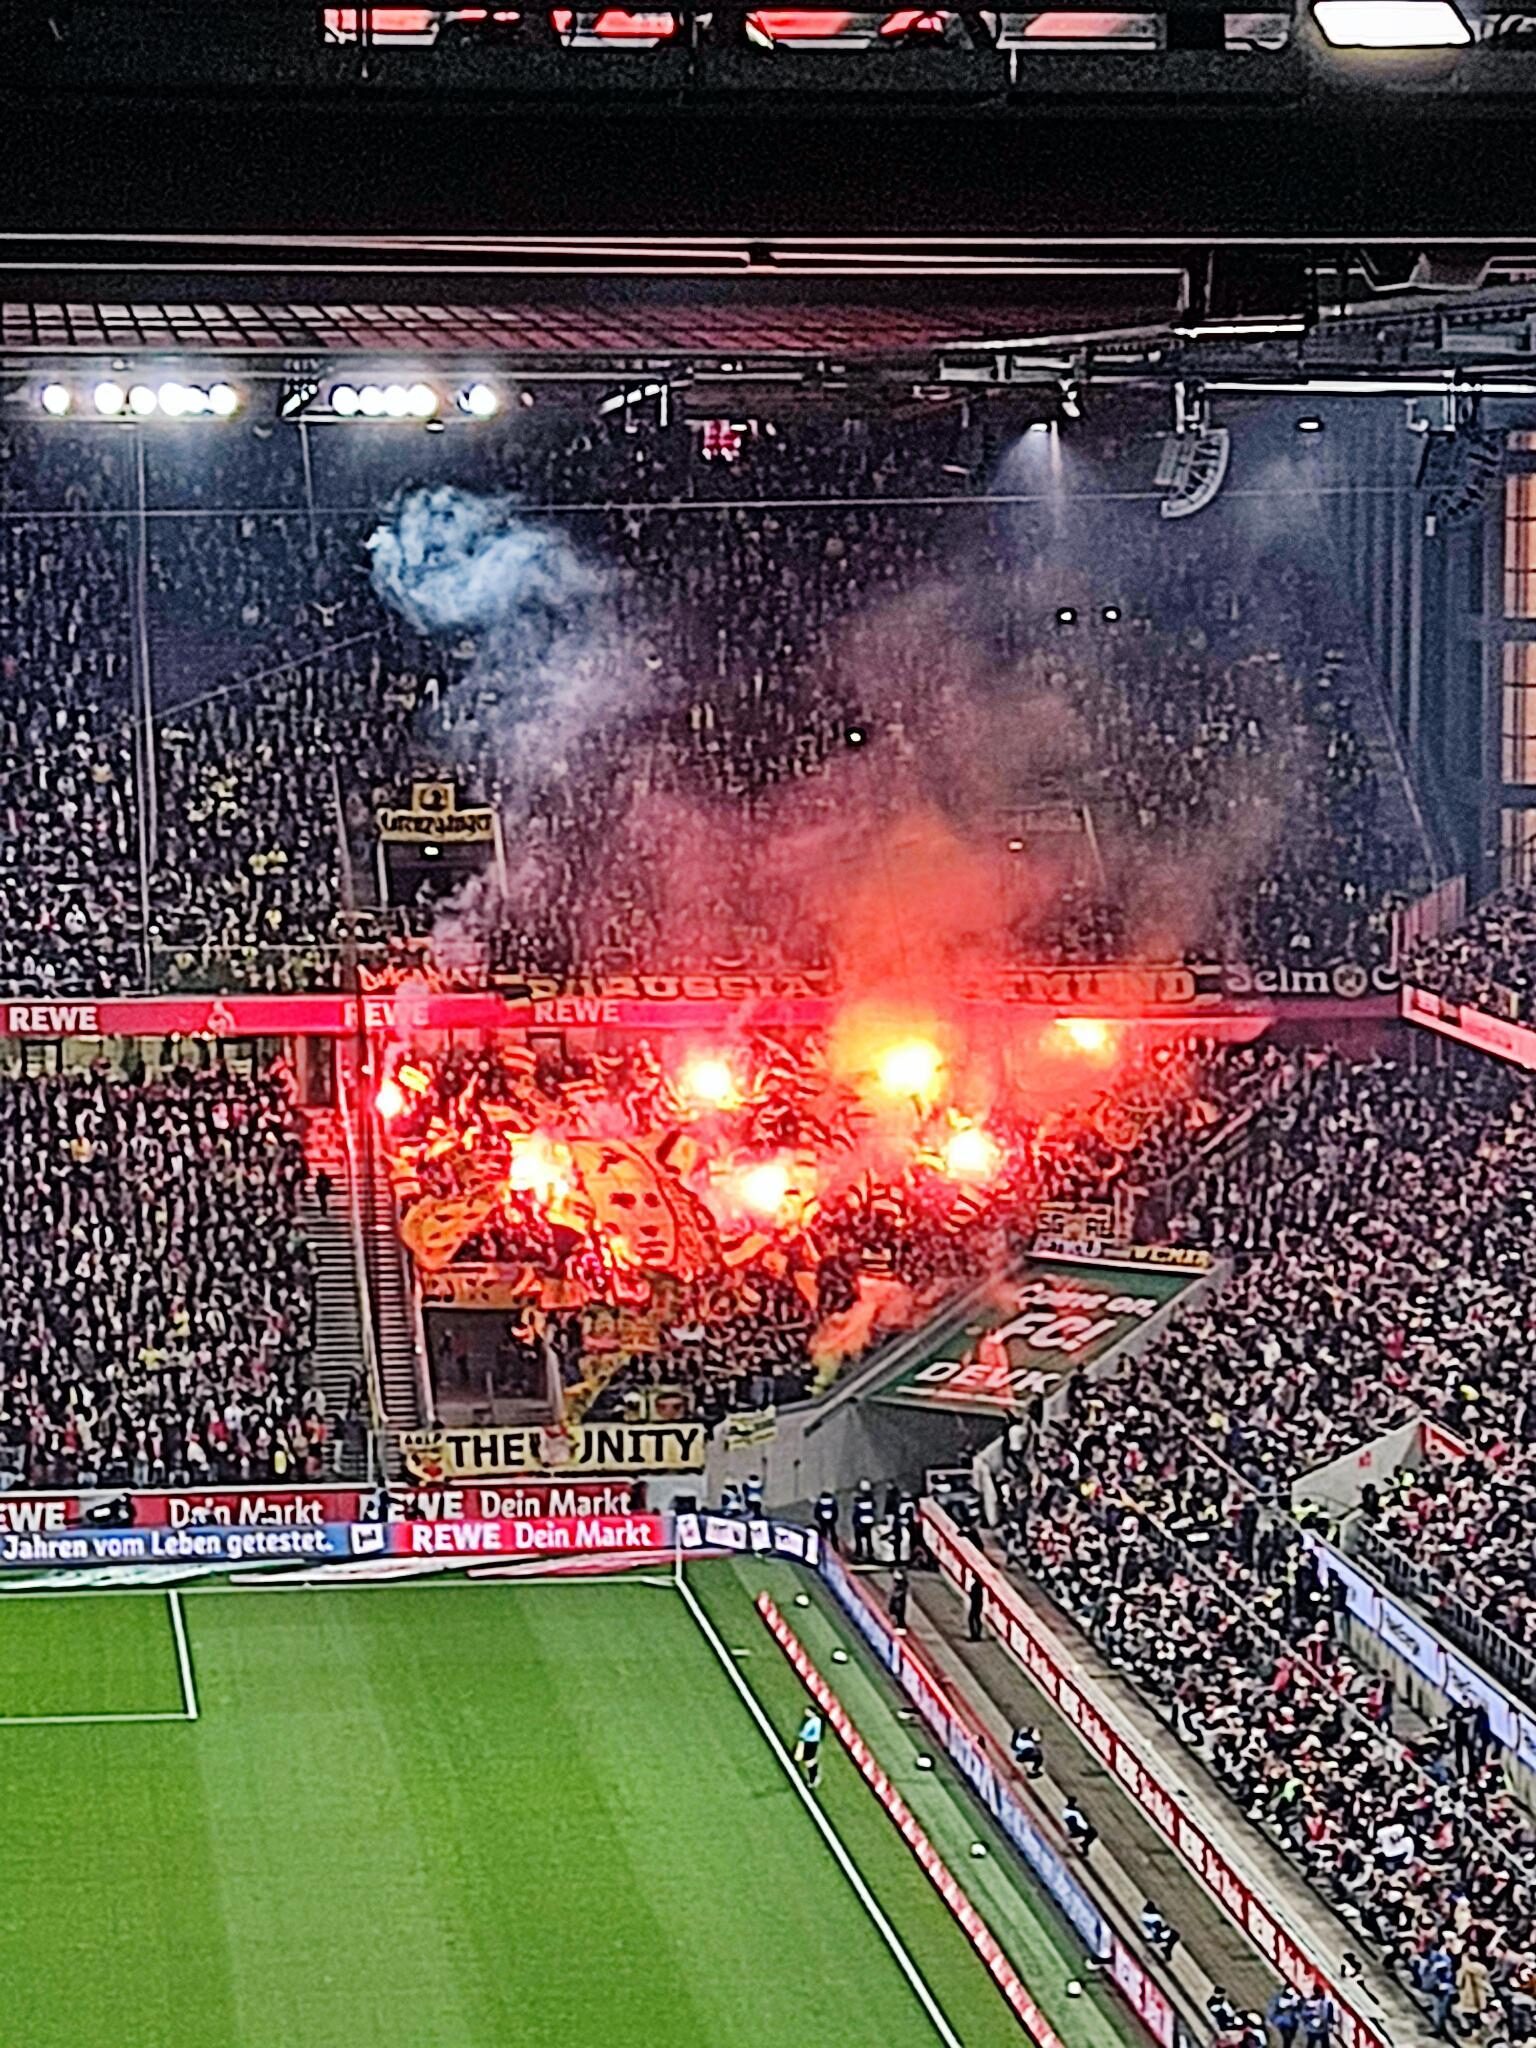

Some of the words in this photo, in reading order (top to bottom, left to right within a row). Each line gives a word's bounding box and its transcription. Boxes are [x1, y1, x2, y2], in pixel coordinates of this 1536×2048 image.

[1225, 964, 1330, 993] Selm
[9, 1006, 98, 1032] REWE
[534, 1001, 620, 1024] REWE
[986, 1312, 1118, 1351] FC!
[914, 1361, 1062, 1394] DEVK
[446, 1432, 525, 1468] THE
[480, 1489, 540, 1518] Dein
[549, 1488, 631, 1517] Markt
[2, 1533, 88, 1560] Jahren
[92, 1536, 145, 1557] vom
[151, 1529, 221, 1556] Leben
[227, 1531, 334, 1559] getestet.
[412, 1523, 502, 1553] REWE
[513, 1521, 570, 1549] Dein
[574, 1519, 652, 1548] Markt
